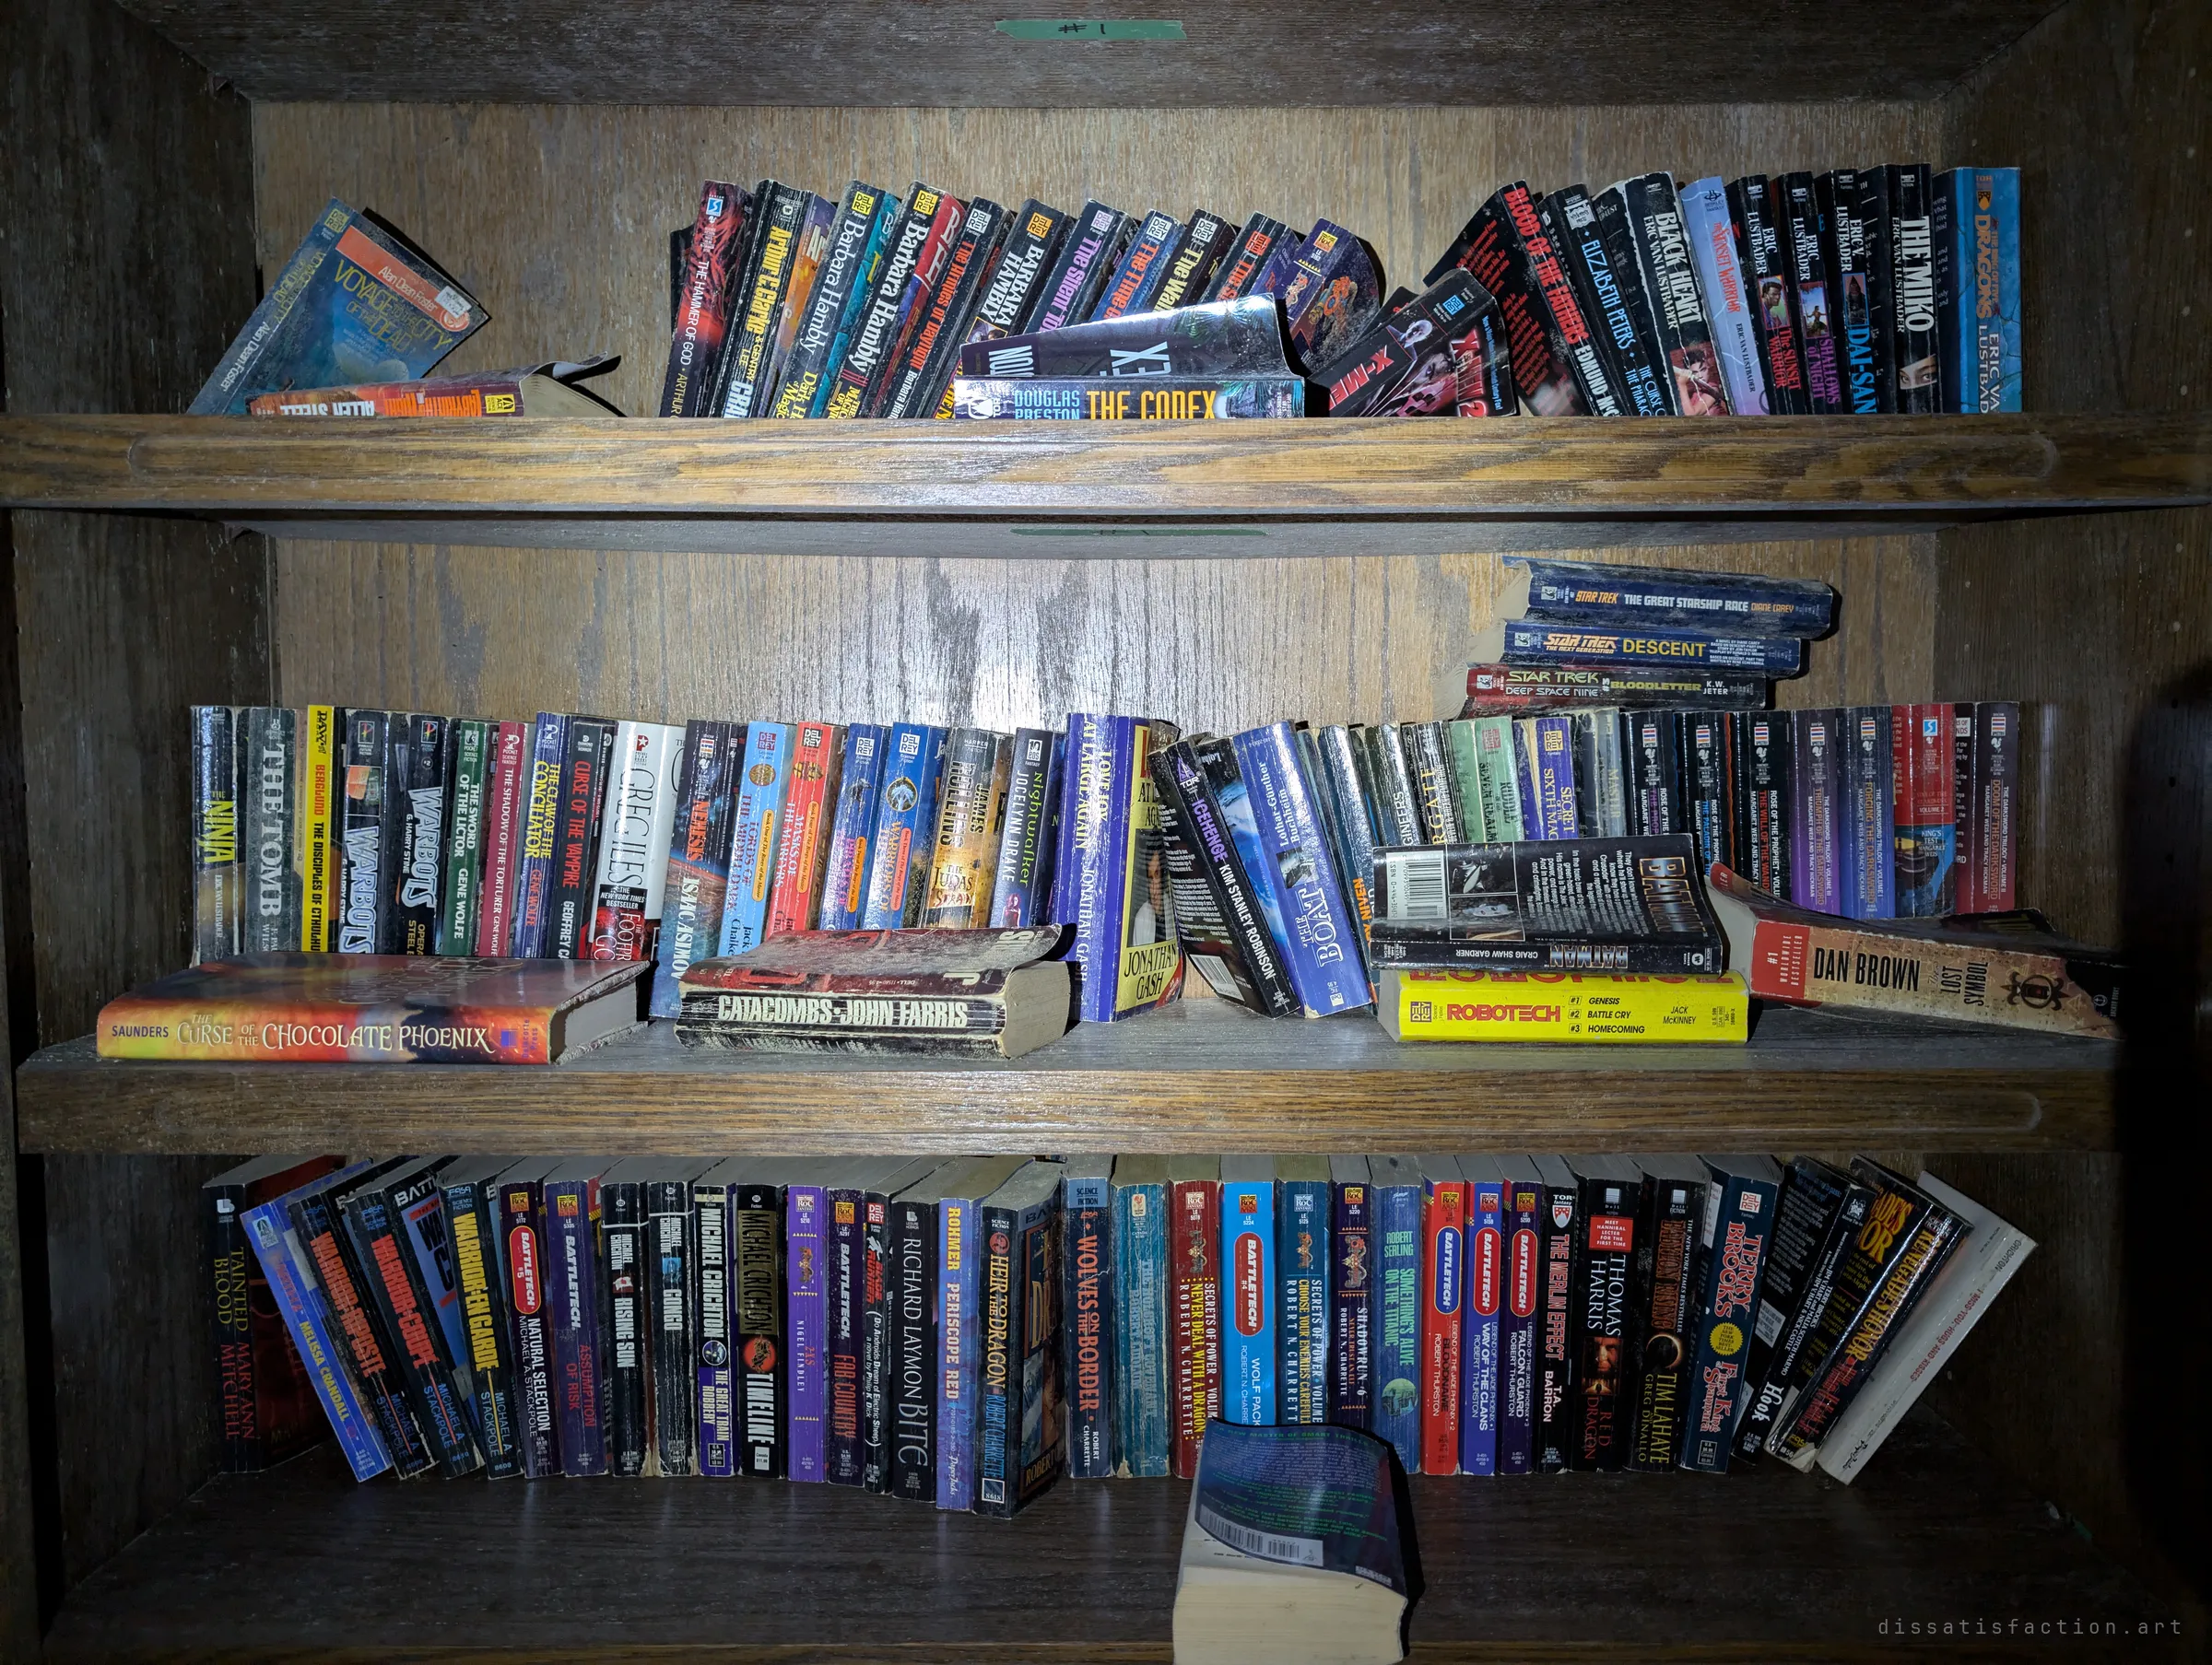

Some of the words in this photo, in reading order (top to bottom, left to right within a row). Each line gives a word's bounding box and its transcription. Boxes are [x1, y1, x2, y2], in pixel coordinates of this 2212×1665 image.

[1058, 23, 1088, 33] #
[1504, 186, 1537, 238] BLOOD
[1643, 216, 1656, 242] ERIC
[1892, 217, 1901, 240] ERIC
[1900, 216, 1930, 261] THE
[830, 219, 866, 287] Barbara
[1525, 237, 1551, 259] OF
[1650, 243, 1665, 268] VAN
[1893, 241, 1901, 264] VAN
[697, 261, 710, 284] THE
[1535, 256, 1563, 287] THE
[1655, 212, 1677, 266] BLACK
[1673, 267, 1703, 323] HEART
[378, 265, 397, 285] Alan
[394, 278, 418, 298] Dean
[415, 291, 437, 311] Foster
[982, 251, 1024, 322] HAMBLY
[1000, 244, 1044, 325] BARBARA
[1581, 239, 1620, 311] ELIZABETH
[1611, 307, 1635, 350] PETERS
[1656, 266, 1677, 330] LUSTBADER
[1894, 267, 1905, 332] LUSTBADER
[1901, 262, 1935, 331] MIKO
[689, 285, 707, 323] HAMMER
[1545, 287, 1589, 345] FATHERS
[686, 324, 699, 339] OF
[799, 287, 843, 357] Hambly
[679, 340, 694, 365] GOD
[1847, 327, 1877, 414] DAI-SAN
[1014, 391, 1080, 407] DOUGLAS
[1576, 591, 1596, 602] STAR
[1598, 592, 1619, 604] TREK
[1624, 594, 1642, 605] THE
[1644, 596, 1672, 607] GREAT
[1674, 597, 1723, 610] STARSHIP
[1724, 600, 1749, 612] RACE
[1751, 603, 1771, 612] DIANE
[1772, 604, 1794, 614] CAREY
[1543, 634, 1580, 647] STAR
[1582, 636, 1620, 648] TREK
[1623, 639, 1706, 657] DESCENT
[1505, 686, 1534, 696] DEEP
[1573, 688, 1598, 697] NINE
[1506, 671, 1551, 684] STAR
[1555, 672, 1598, 684] TREK
[1602, 678, 1610, 692] #3
[1610, 682, 1701, 691] BLOODLETTER
[1707, 680, 1724, 688] K.W.
[313, 765, 325, 815] BERGLUND
[461, 774, 469, 788] OF
[468, 782, 479, 807] THE
[1992, 780, 2000, 805] DOOM
[458, 790, 469, 814] THE
[1007, 771, 1029, 835] JOCELYNN
[1991, 806, 2000, 820] OF
[195, 800, 235, 862] NINJA
[314, 823, 324, 839] THE
[454, 815, 468, 858] LICTOR
[467, 807, 478, 850] SWORD
[1021, 771, 1043, 886] Nightwalker
[1991, 822, 2000, 840] THE
[312, 841, 324, 889] DISCIPLES
[1002, 841, 1018, 882] DRAKE
[1990, 841, 2000, 901] DARKSWORD
[312, 890, 323, 906] OF
[458, 869, 468, 896] GENE
[1192, 799, 1228, 862] ICEHENGE
[1219, 863, 1237, 888] KIM
[1230, 885, 1253, 928] STANLEY
[1246, 928, 1276, 980] ROBINSON
[310, 907, 323, 950] CTHULHU
[453, 900, 466, 939] WOLFE
[1295, 916, 1312, 948] THE
[1297, 888, 1342, 967] BOAT
[1123, 944, 1177, 976] JONATHAN
[1456, 949, 1488, 958] GARDNER
[1491, 950, 1512, 958] SHAW
[1514, 950, 1538, 958] CRAIG
[1550, 946, 1628, 967] BATMAN
[1814, 948, 1849, 983] DAN
[1855, 954, 1921, 991] BROWN
[1939, 967, 1963, 994] LOST
[1963, 961, 1988, 1006] SYMBOL
[1136, 974, 1163, 1000] GASH
[1570, 995, 1581, 1005] #1
[1588, 996, 1620, 1005] GENESIS
[191, 1014, 214, 1026] THE
[899, 1002, 968, 1027] FARRIS
[1447, 1004, 1560, 1023] ROBOTECH
[1570, 1010, 1581, 1019] #2
[1587, 1010, 1614, 1019] BATTLE
[1616, 1011, 1630, 1020] CRY
[1663, 1014, 1696, 1025] McKINNEY
[1670, 1006, 1688, 1014] JACK
[112, 1025, 170, 1038] SAUNDERS
[177, 1024, 232, 1047] CURSE
[238, 1037, 259, 1047] THE
[241, 1026, 255, 1037] OF
[262, 1024, 393, 1051] CHOCOLATE
[397, 1026, 496, 1053] PHOENIX
[1570, 1024, 1581, 1033] #3
[1588, 1025, 1645, 1034] HOMECOMING
[700, 1208, 722, 1266] MICHAEL
[947, 1207, 960, 1272] ROHMER
[1384, 1244, 1414, 1256] SERLING
[1386, 1231, 1413, 1243] ROBERT
[520, 1233, 535, 1310] BATTLETECH
[902, 1237, 922, 1319] RICHARD
[1077, 1235, 1099, 1309] WOLVES
[1384, 1269, 1398, 1283] ON
[1443, 1232, 1453, 1307] BATTLETECH
[1482, 1233, 1493, 1311] BATTLETECH
[1714, 1221, 1746, 1319] BROOKS
[1734, 1236, 1763, 1312] TERRY
[215, 1257, 232, 1325] BLOOD
[230, 1247, 249, 1332] TAINTED
[701, 1269, 724, 1338] CRICHTON
[1384, 1284, 1398, 1305] THE
[1399, 1270, 1415, 1334] SOMETHING'S
[1587, 1260, 1606, 1329] HARRIS
[1606, 1255, 1626, 1336] THOMAS
[615, 1297, 633, 1340] RISING
[664, 1289, 683, 1331] CONGO
[946, 1284, 960, 1364] PERISCOPE
[1078, 1312, 1089, 1334] THE
[1090, 1312, 1100, 1333] ON
[1384, 1307, 1399, 1347] TITANIC
[528, 1319, 544, 1369] NATURAL
[617, 1342, 635, 1368] SUN
[1399, 1337, 1414, 1366] ALIVE
[903, 1324, 923, 1398] LAYMON
[1078, 1336, 1099, 1411] BORDER
[715, 1370, 727, 1386] THE
[946, 1367, 959, 1400] RED
[534, 1372, 550, 1431] SELECTION
[702, 1385, 715, 1425] ROBBERY
[716, 1388, 728, 1413] GREAT
[747, 1373, 775, 1445] TIMELINE
[1752, 1382, 1784, 1422] Hook
[716, 1416, 729, 1441] TRAIN
